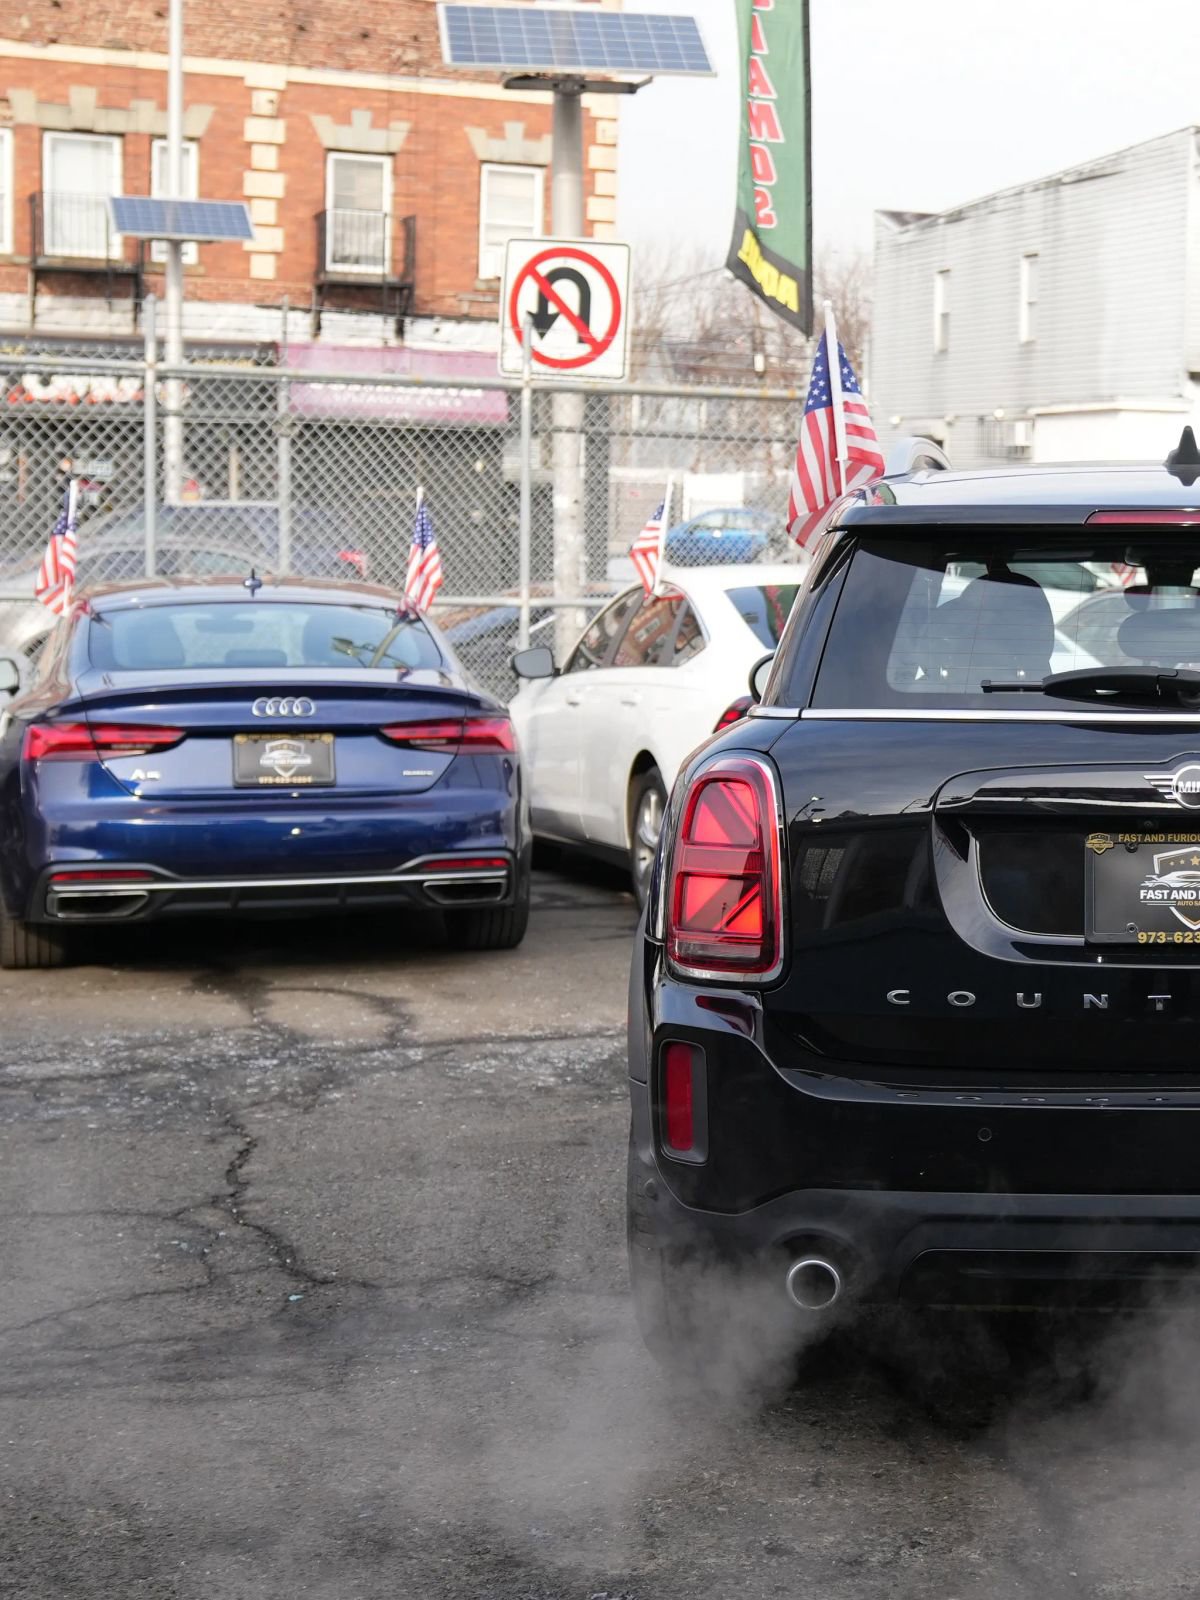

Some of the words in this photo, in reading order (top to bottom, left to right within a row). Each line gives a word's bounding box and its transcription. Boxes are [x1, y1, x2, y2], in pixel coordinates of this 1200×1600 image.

[1118, 833, 1142, 843] FAST
[1144, 833, 1166, 843] AND
[1140, 889, 1169, 900] FAST
[1171, 889, 1197, 900] AND
